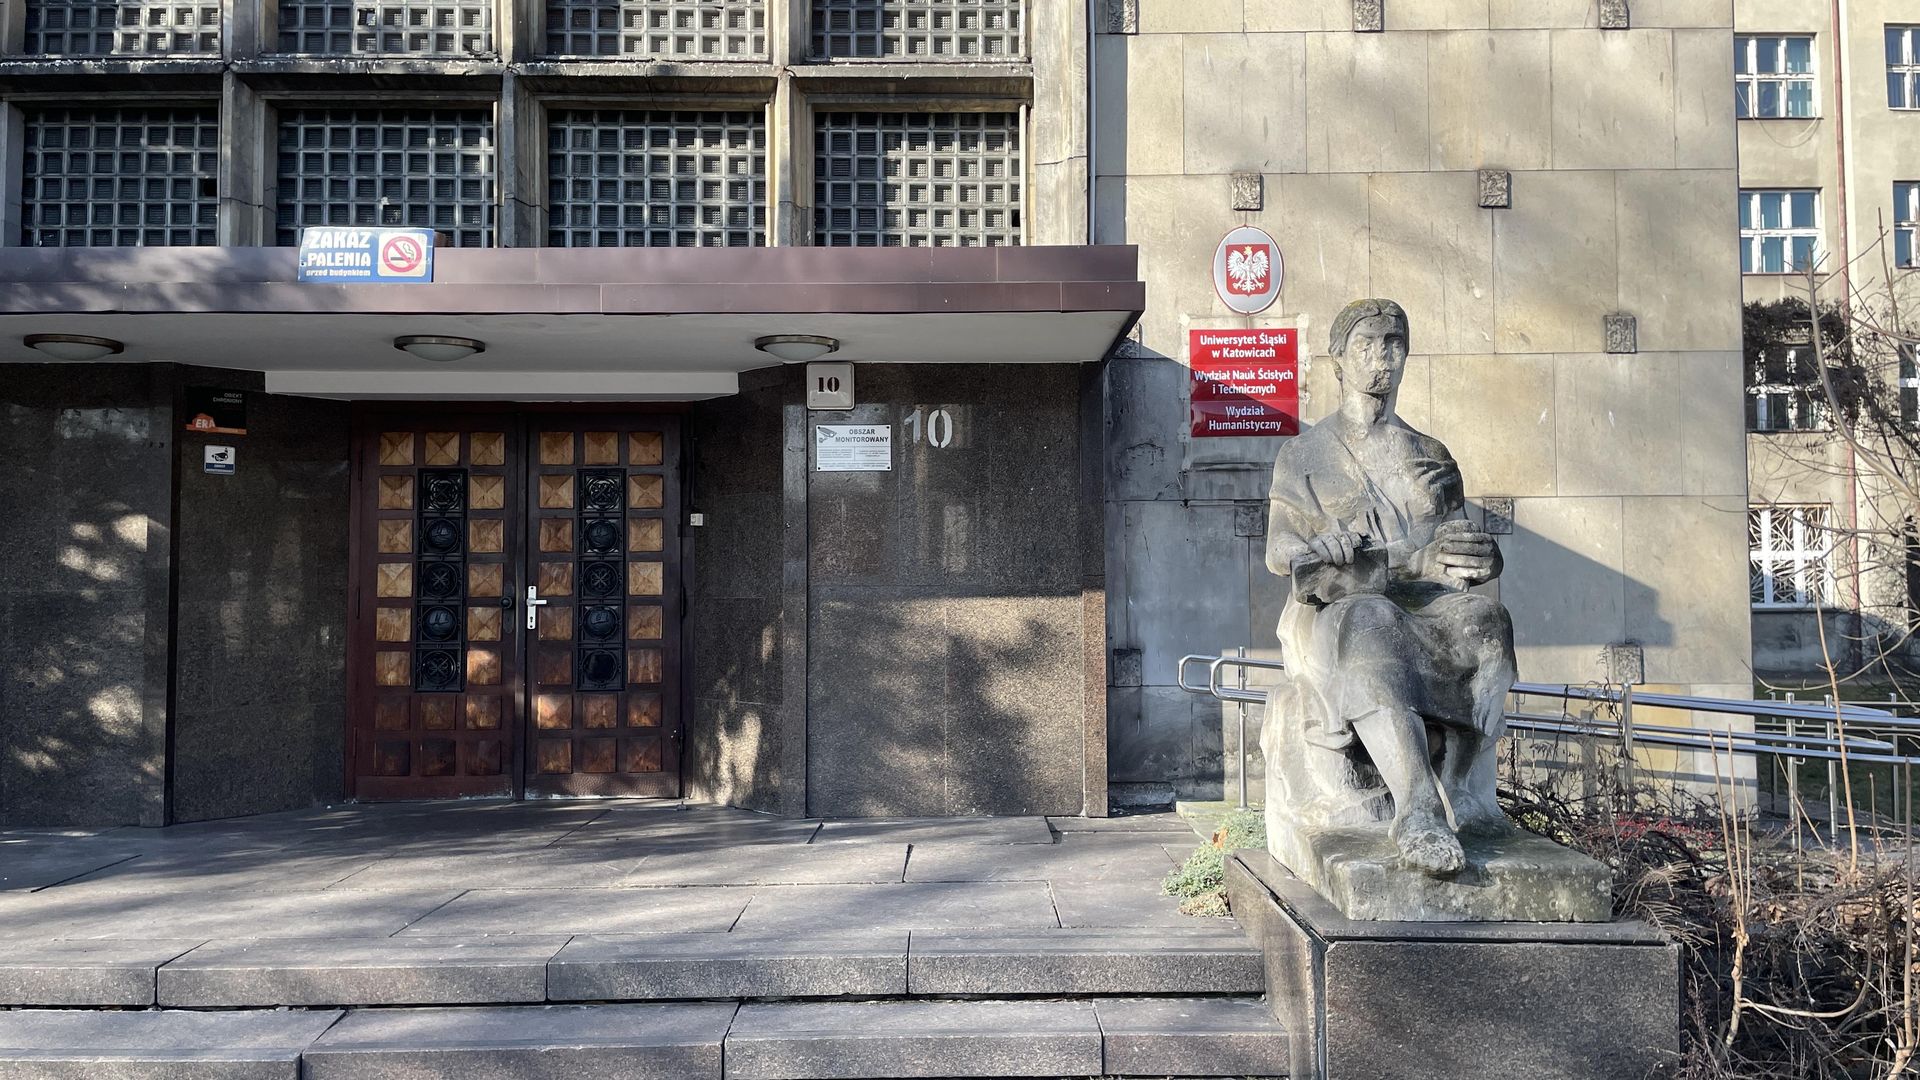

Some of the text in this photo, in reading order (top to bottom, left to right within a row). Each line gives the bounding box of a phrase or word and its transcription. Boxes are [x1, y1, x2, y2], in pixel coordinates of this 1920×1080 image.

[309, 231, 371, 248] ZAKAZ
[307, 252, 371, 267] PALENIA
[307, 269, 371, 277] przed budynkiem
[1200, 333, 1287, 346] Uniwersytet Śląski
[1212, 347, 1276, 358] w Katowicach
[1194, 368, 1294, 382] Wydział Nauk Ścisłych
[817, 376, 840, 393] 10
[1212, 383, 1277, 396] i Technicznych
[1225, 406, 1265, 418] Wydział
[196, 419, 215, 428] ERA
[903, 409, 953, 449] 10
[1208, 420, 1282, 431] Humanistyczny
